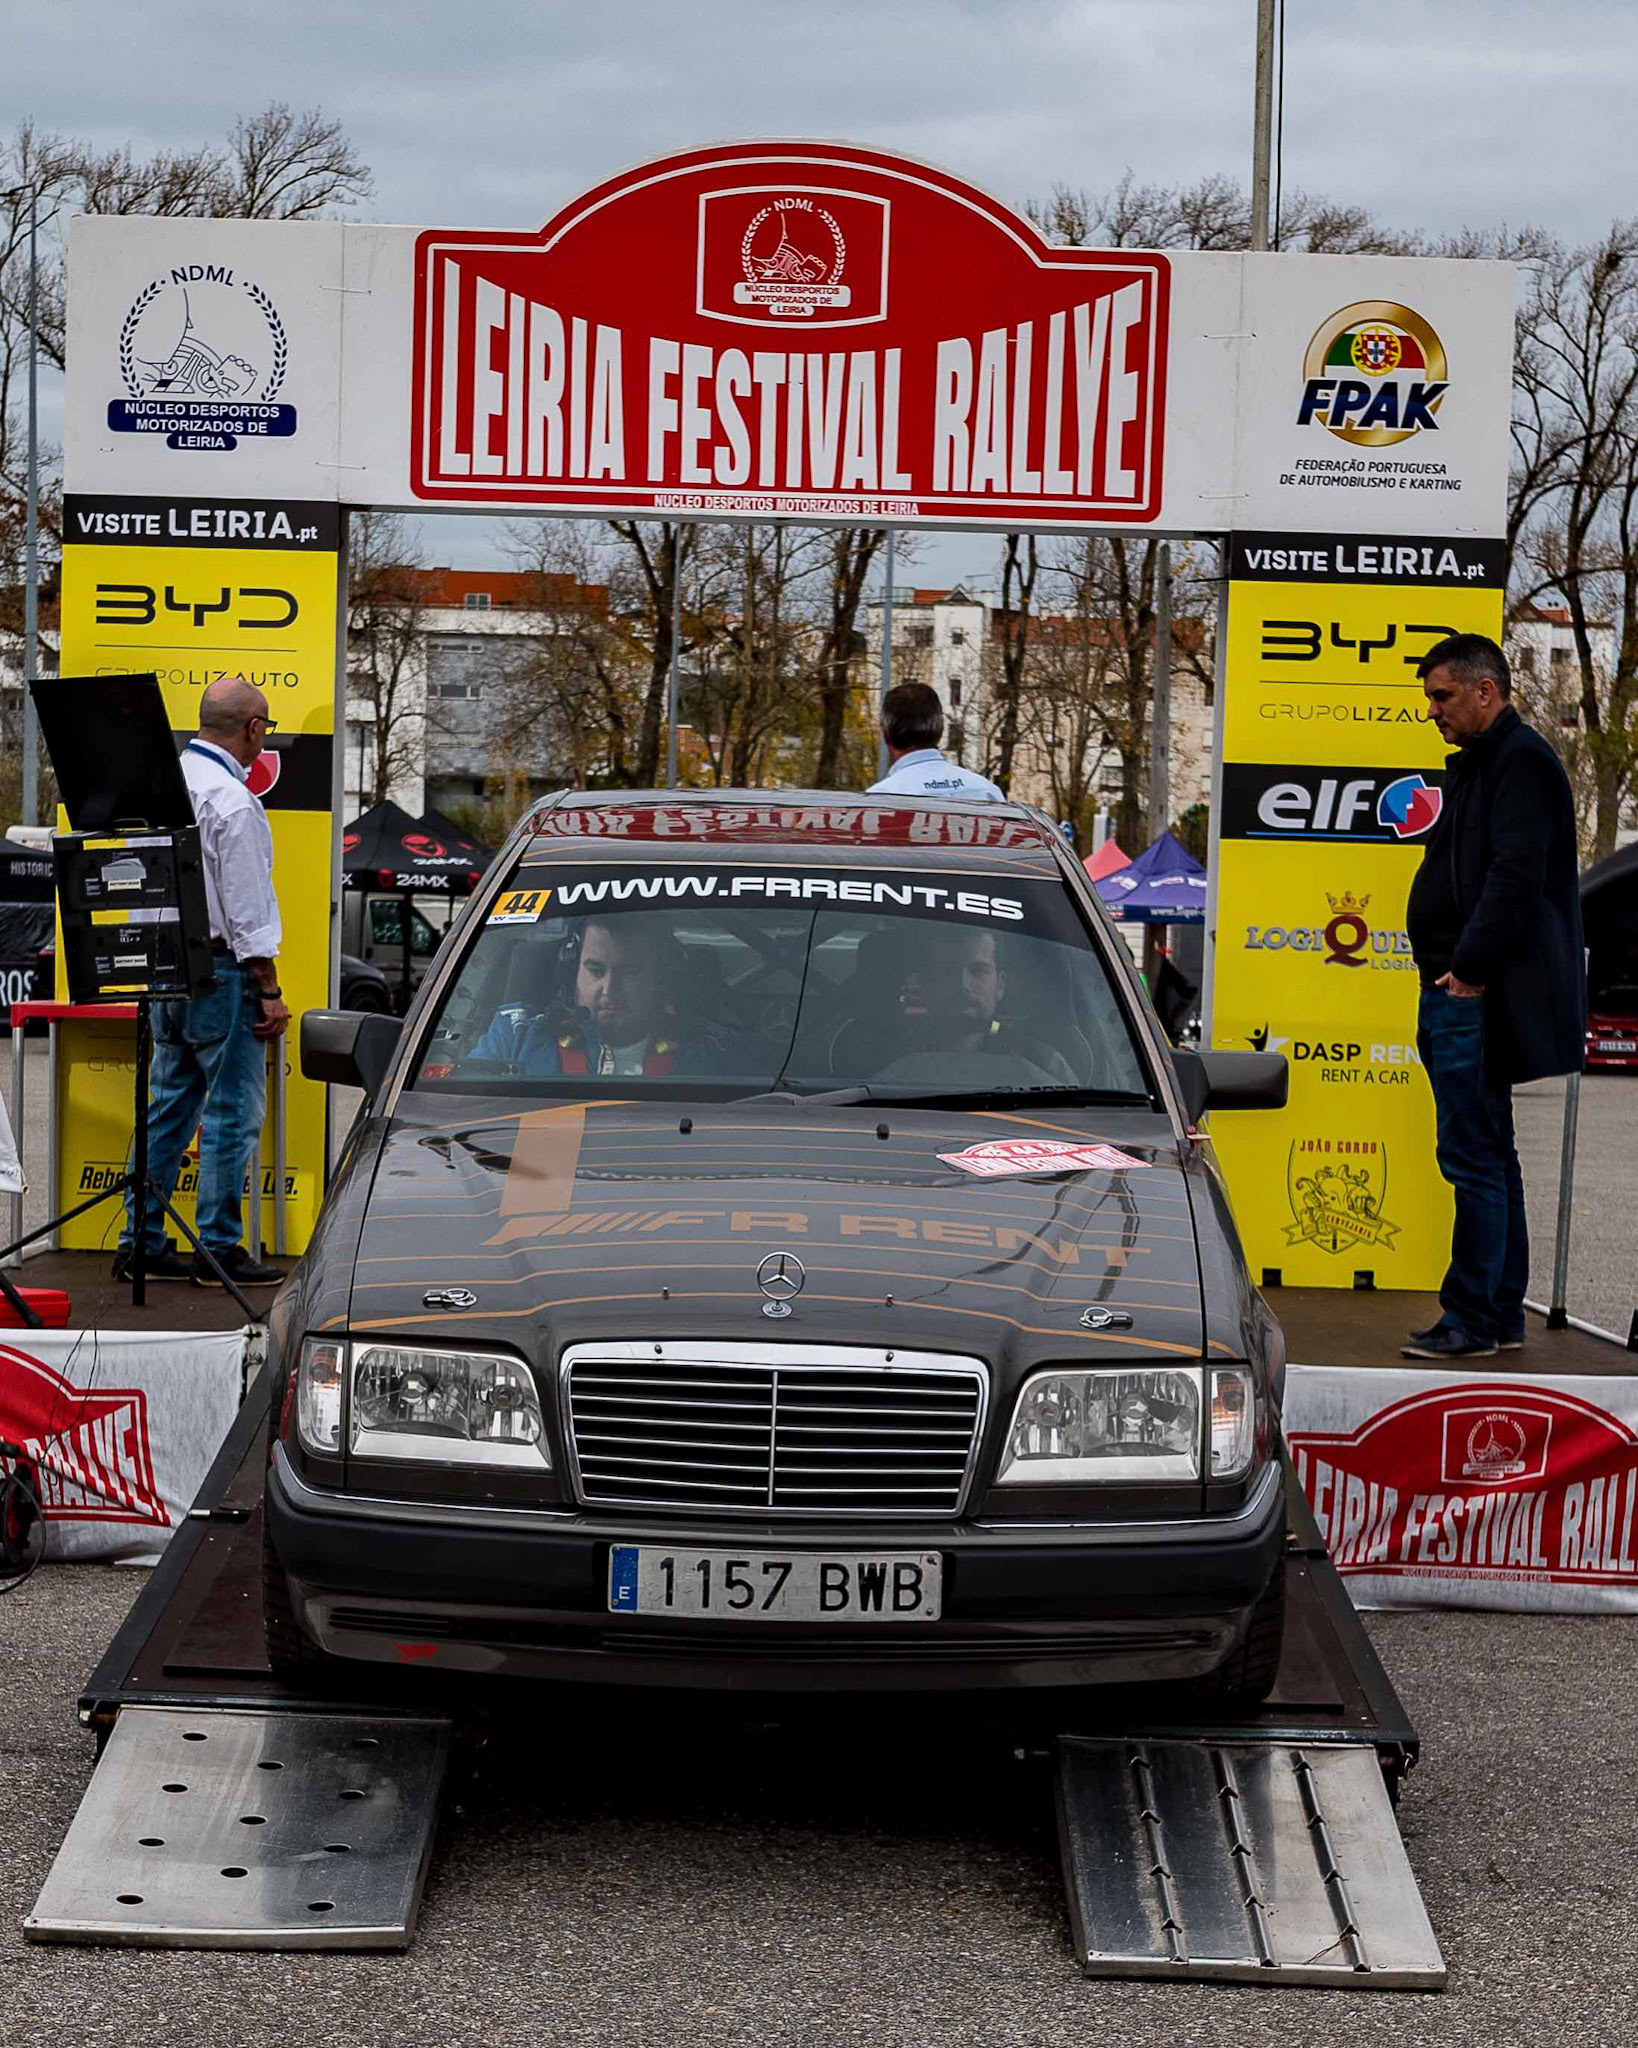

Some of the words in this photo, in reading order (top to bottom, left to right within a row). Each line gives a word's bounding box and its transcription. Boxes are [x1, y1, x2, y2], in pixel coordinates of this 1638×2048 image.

[773, 198, 814, 212] NDML
[171, 265, 235, 287] NDML
[751, 294, 817, 304] MOTORIZADOS
[820, 297, 833, 305] DE
[784, 285, 840, 296] DESPORTOS
[776, 305, 807, 314] LEIRIA
[438, 256, 626, 481] LEIRIA
[646, 336, 912, 492] FESTIVAL
[933, 278, 1144, 499] RALLYE
[125, 400, 186, 416] NÚCLEO
[189, 404, 280, 418] DESPORTOS
[1295, 378, 1450, 431] FPAK
[136, 418, 244, 433] MOTORIZADOS
[247, 421, 268, 434] DE
[177, 435, 226, 448] LEIRIA
[1295, 458, 1365, 474] FEDERAÇÃO
[1368, 461, 1447, 475] PORTUGUESA
[1280, 474, 1296, 485] DE
[1298, 475, 1396, 488] AUTOMOBILISMO
[1399, 478, 1407, 489] E
[1409, 478, 1462, 491] KARTING
[704, 496, 774, 512] DESPORTOS
[776, 498, 859, 514] MOTORIZADOS
[862, 501, 878, 515] DE
[881, 502, 920, 516] LEIRIA
[77, 513, 161, 535] VISITE
[167, 508, 318, 543] LEIRIA.pt
[1244, 548, 1328, 572] VISITE
[1335, 545, 1485, 580] LEIRIA.pt
[95, 584, 299, 628] BYD
[1259, 703, 1429, 723] GRUPOLIZAU
[1257, 778, 1376, 831] elf
[396, 873, 450, 888] 24MX
[503, 892, 542, 914] 44
[557, 876, 1025, 920] WWW.FRRENT.ES
[1293, 1041, 1362, 1063] DASP
[1369, 1043, 1422, 1064] REN
[1321, 1068, 1361, 1083] RENT
[1364, 1070, 1374, 1083] A
[1378, 1070, 1410, 1084] CAR
[840, 1214, 1151, 1267] RENT
[1400, 1490, 1549, 1568] FESTIVAL
[1558, 1466, 1638, 1572] RALL
[618, 1585, 630, 1600] E
[660, 1556, 793, 1611] 1157
[819, 1561, 924, 1612] BWB
